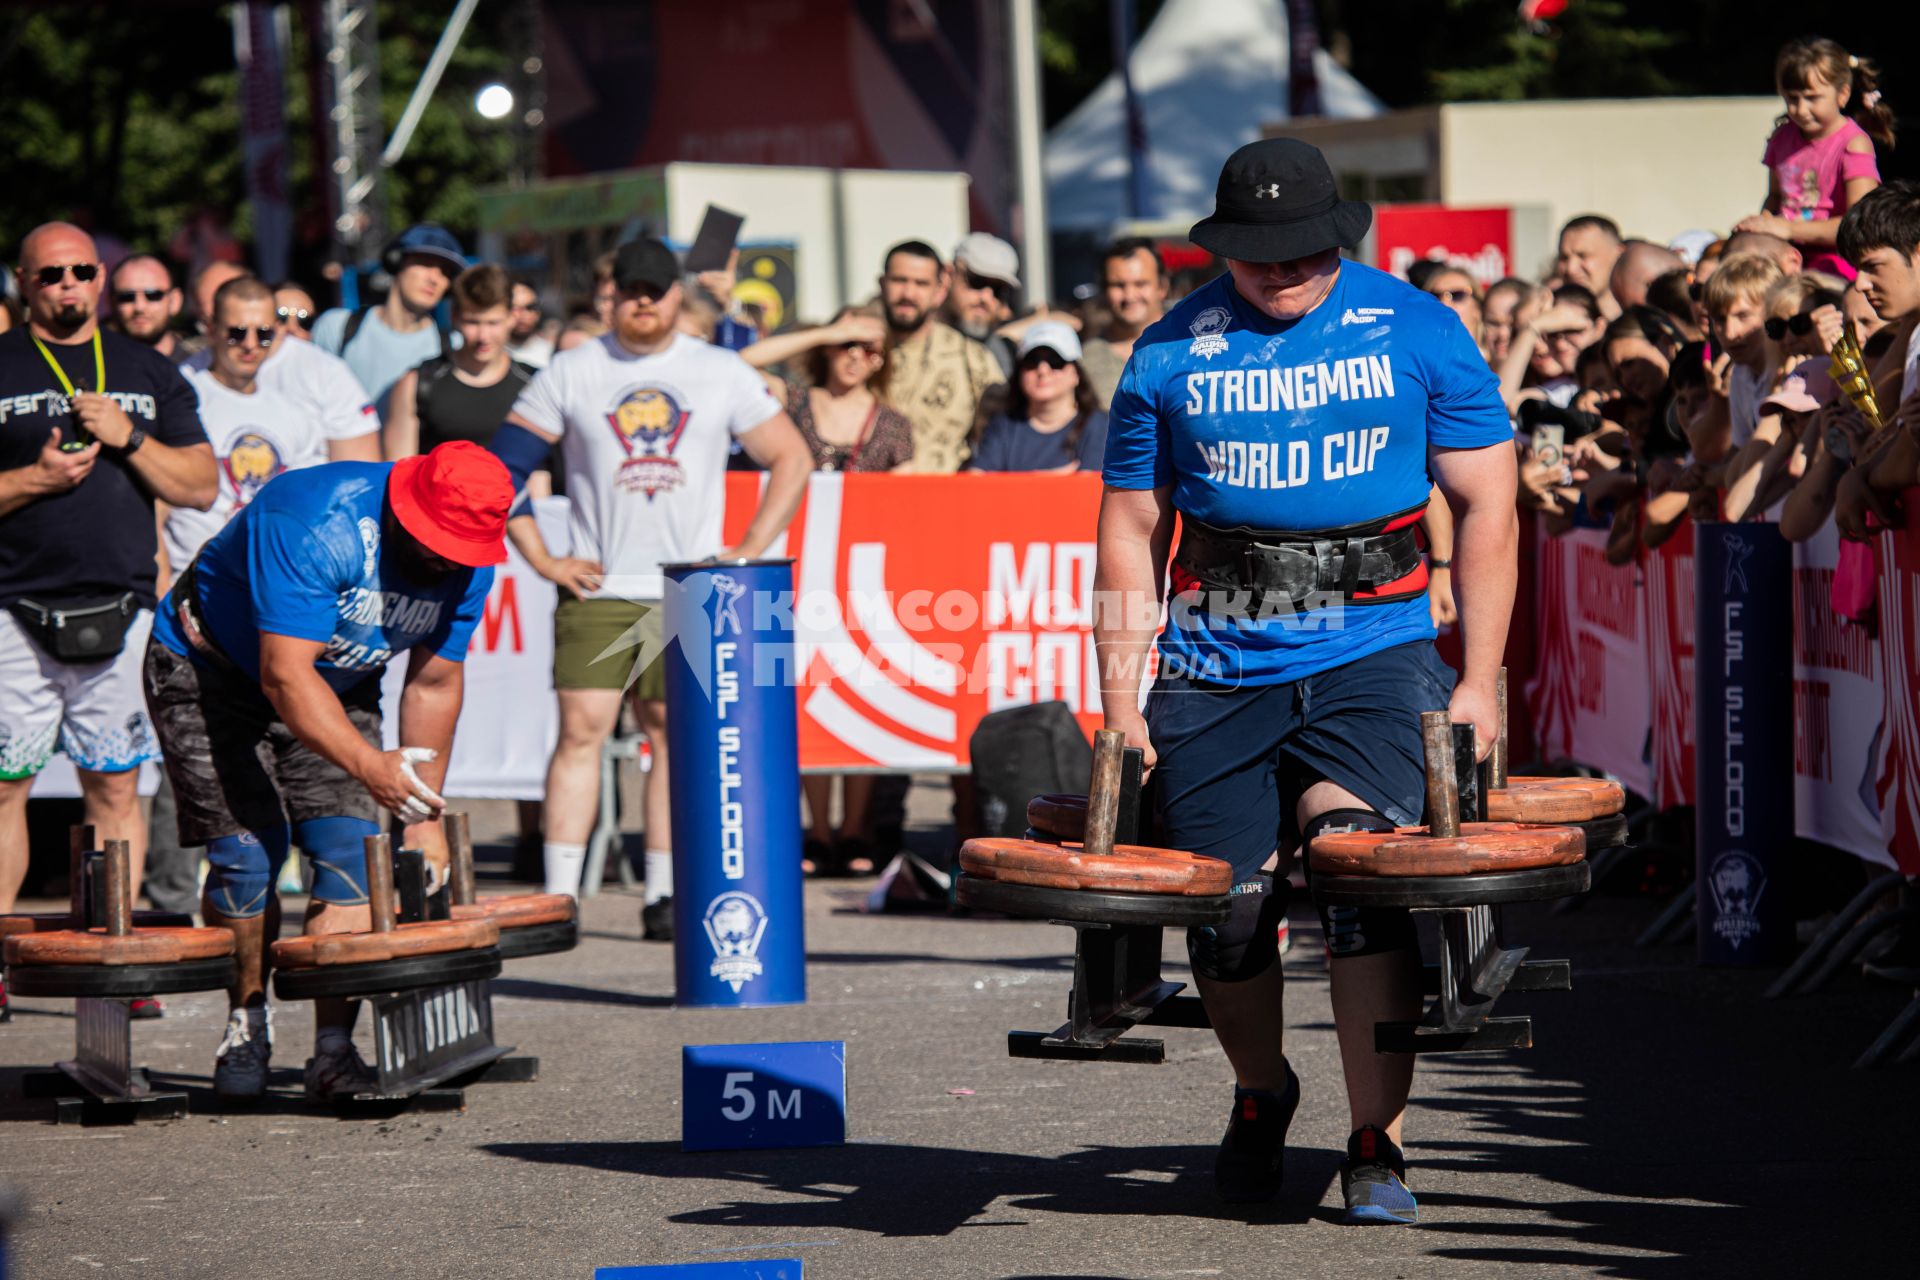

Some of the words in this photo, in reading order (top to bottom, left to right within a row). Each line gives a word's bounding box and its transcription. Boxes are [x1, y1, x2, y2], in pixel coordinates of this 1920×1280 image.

[1186, 354, 1396, 416] STRONGMAN
[1196, 441, 1310, 489] WORLD
[1323, 427, 1390, 481] CUP
[721, 1071, 756, 1121] 5
